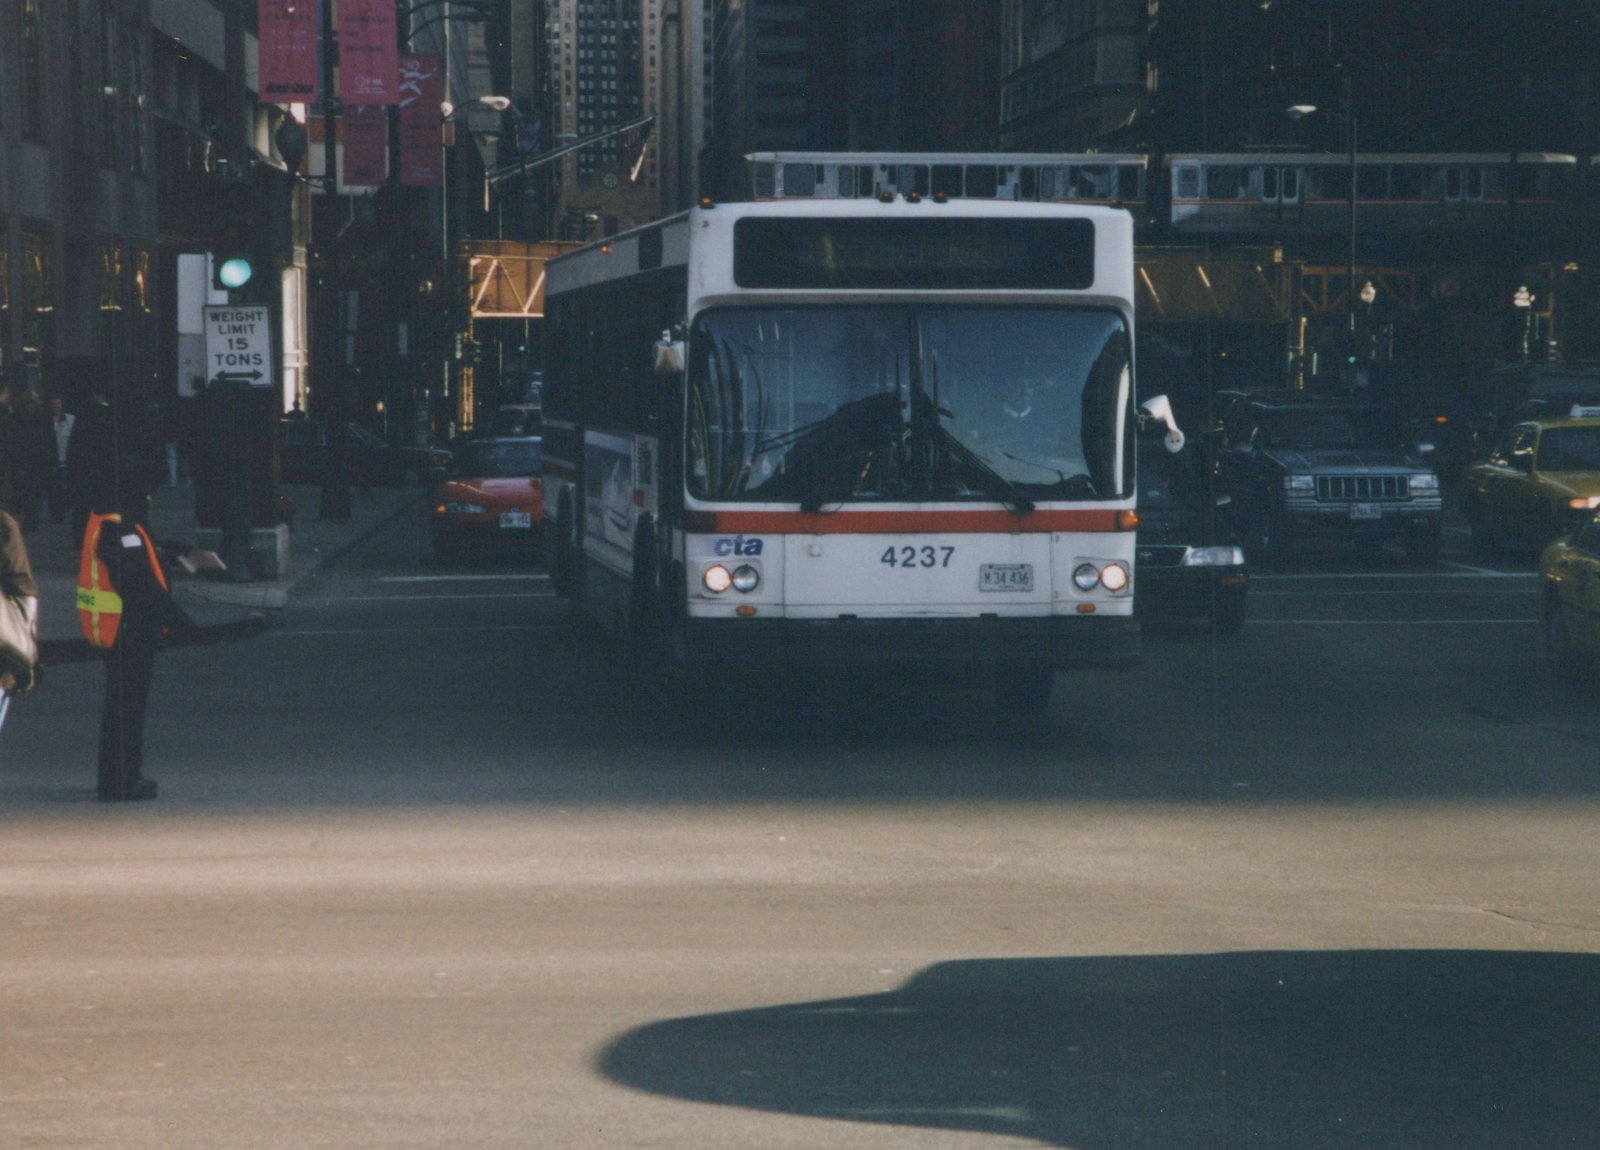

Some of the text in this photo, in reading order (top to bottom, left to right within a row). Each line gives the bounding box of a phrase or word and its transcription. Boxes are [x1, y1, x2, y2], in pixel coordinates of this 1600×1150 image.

[209, 311, 264, 323] WEIGHT
[218, 324, 256, 335] LIMIT
[227, 338, 249, 351] 15
[214, 353, 263, 366] TONS
[714, 534, 764, 556] cta
[881, 546, 955, 568] 4237
